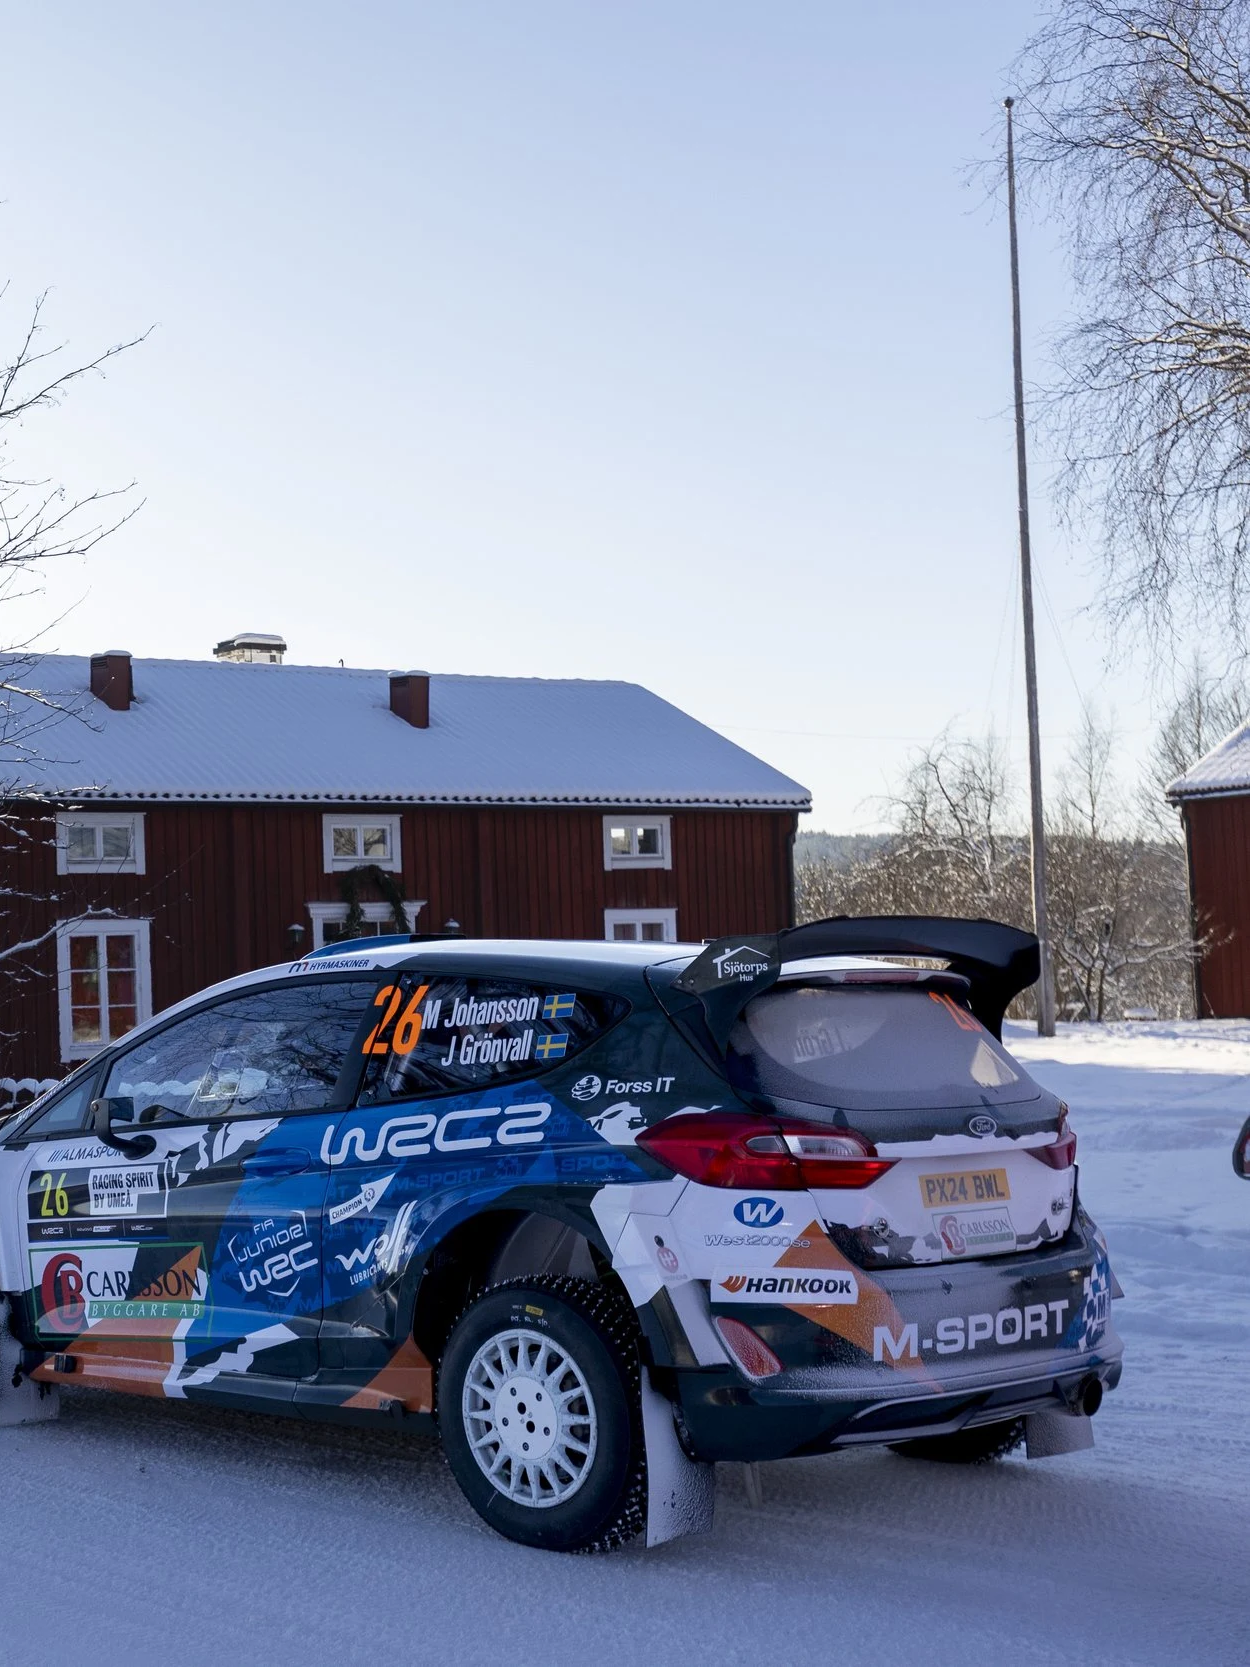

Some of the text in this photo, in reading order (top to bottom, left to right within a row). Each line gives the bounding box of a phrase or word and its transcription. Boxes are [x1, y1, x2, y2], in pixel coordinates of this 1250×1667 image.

[309, 959, 370, 971] HYRMASKINER
[723, 961, 769, 977] Sjötorps
[739, 973, 754, 982] Hus
[362, 985, 430, 1054] 26
[421, 996, 539, 1029] M Johansson
[441, 1030, 533, 1066] J Grönvall
[605, 1077, 675, 1094] Forss IT
[320, 1102, 552, 1165] WRC2
[92, 1171, 154, 1190] RACING SPIRIT
[925, 1174, 1005, 1203] PX24 BWL
[39, 1172, 69, 1216] 26
[94, 1193, 105, 1208] BY
[332, 1198, 363, 1219] CHAMPION
[253, 1218, 275, 1235] FIA
[959, 1219, 1011, 1235] CARLSSON
[237, 1223, 304, 1263] JUNIOR
[239, 1242, 319, 1293] WRC
[350, 1258, 388, 1285] LUBRICANTS
[91, 1303, 200, 1317] BYGGARE AB
[873, 1300, 1069, 1362] M-SPORT
